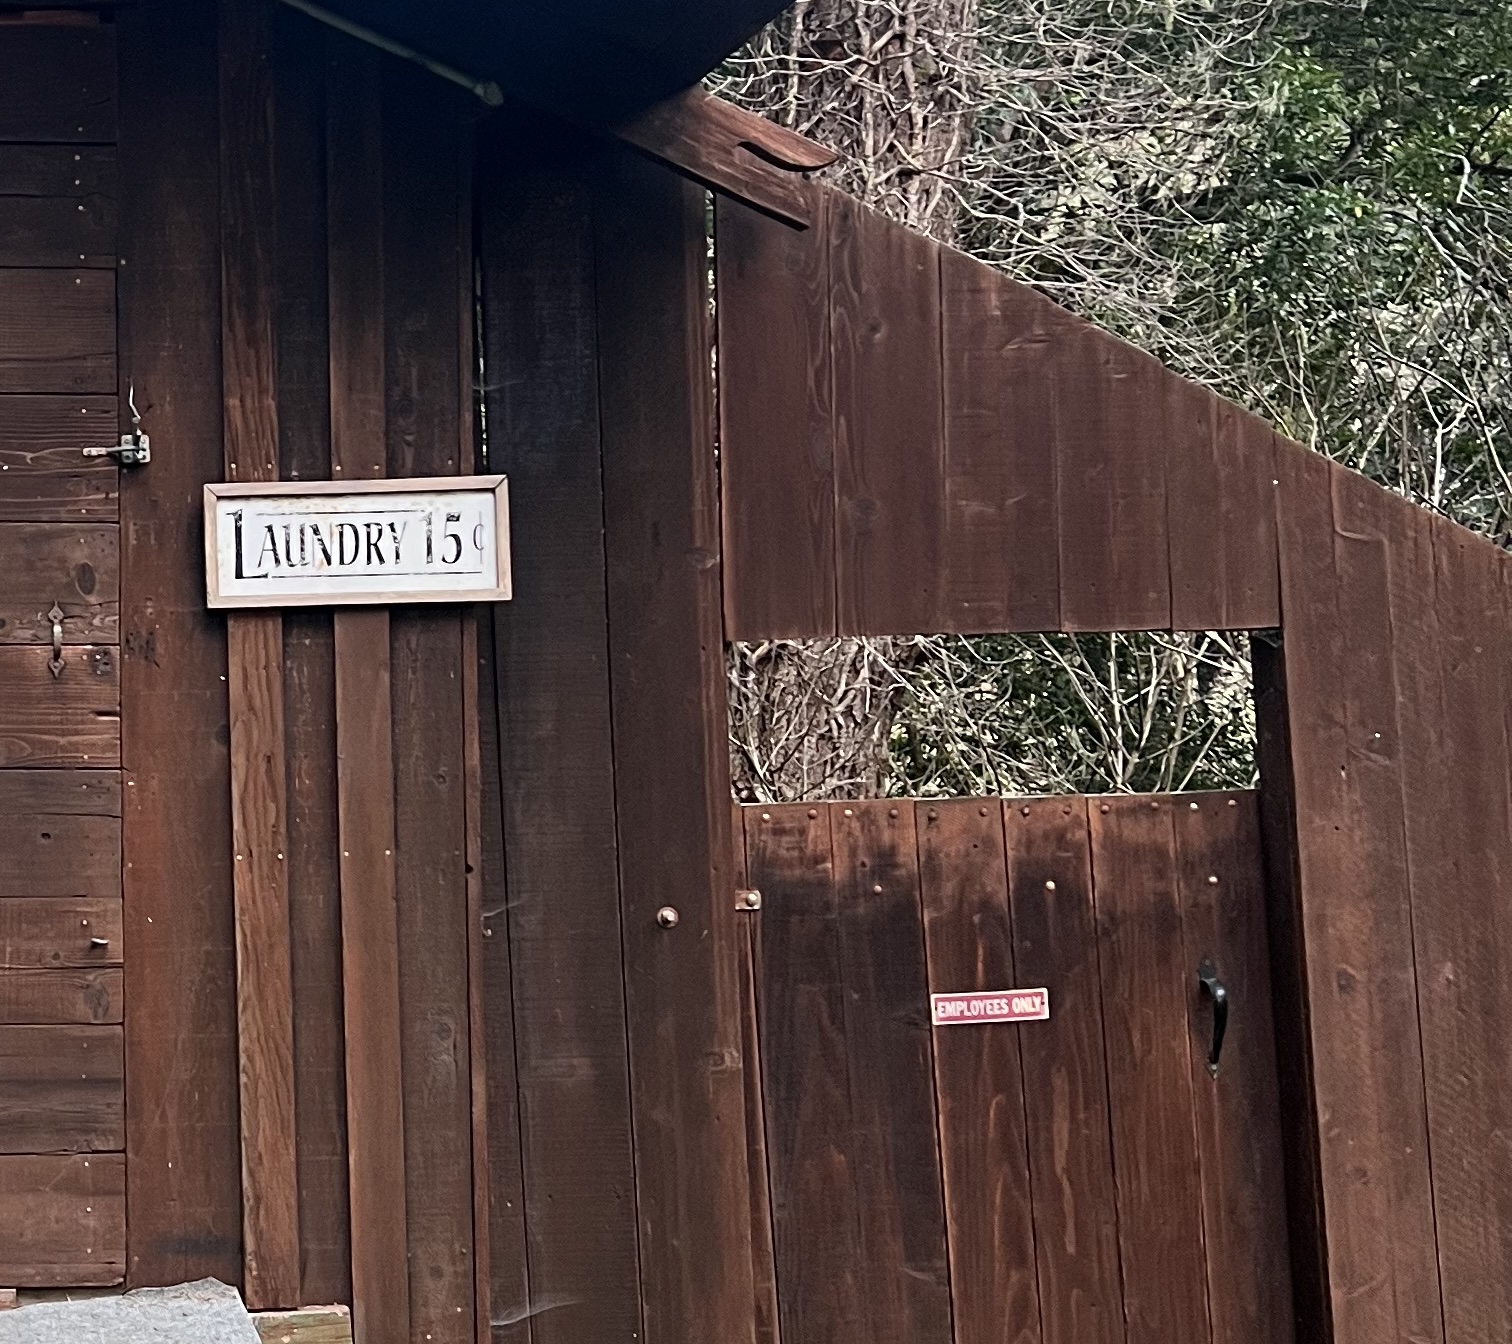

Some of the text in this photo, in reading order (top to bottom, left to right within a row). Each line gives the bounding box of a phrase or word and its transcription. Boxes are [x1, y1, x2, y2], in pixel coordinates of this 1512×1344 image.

[226, 508, 407, 579] LAUNDRY
[937, 996, 1042, 1017] EMPLOYEES ONLY
